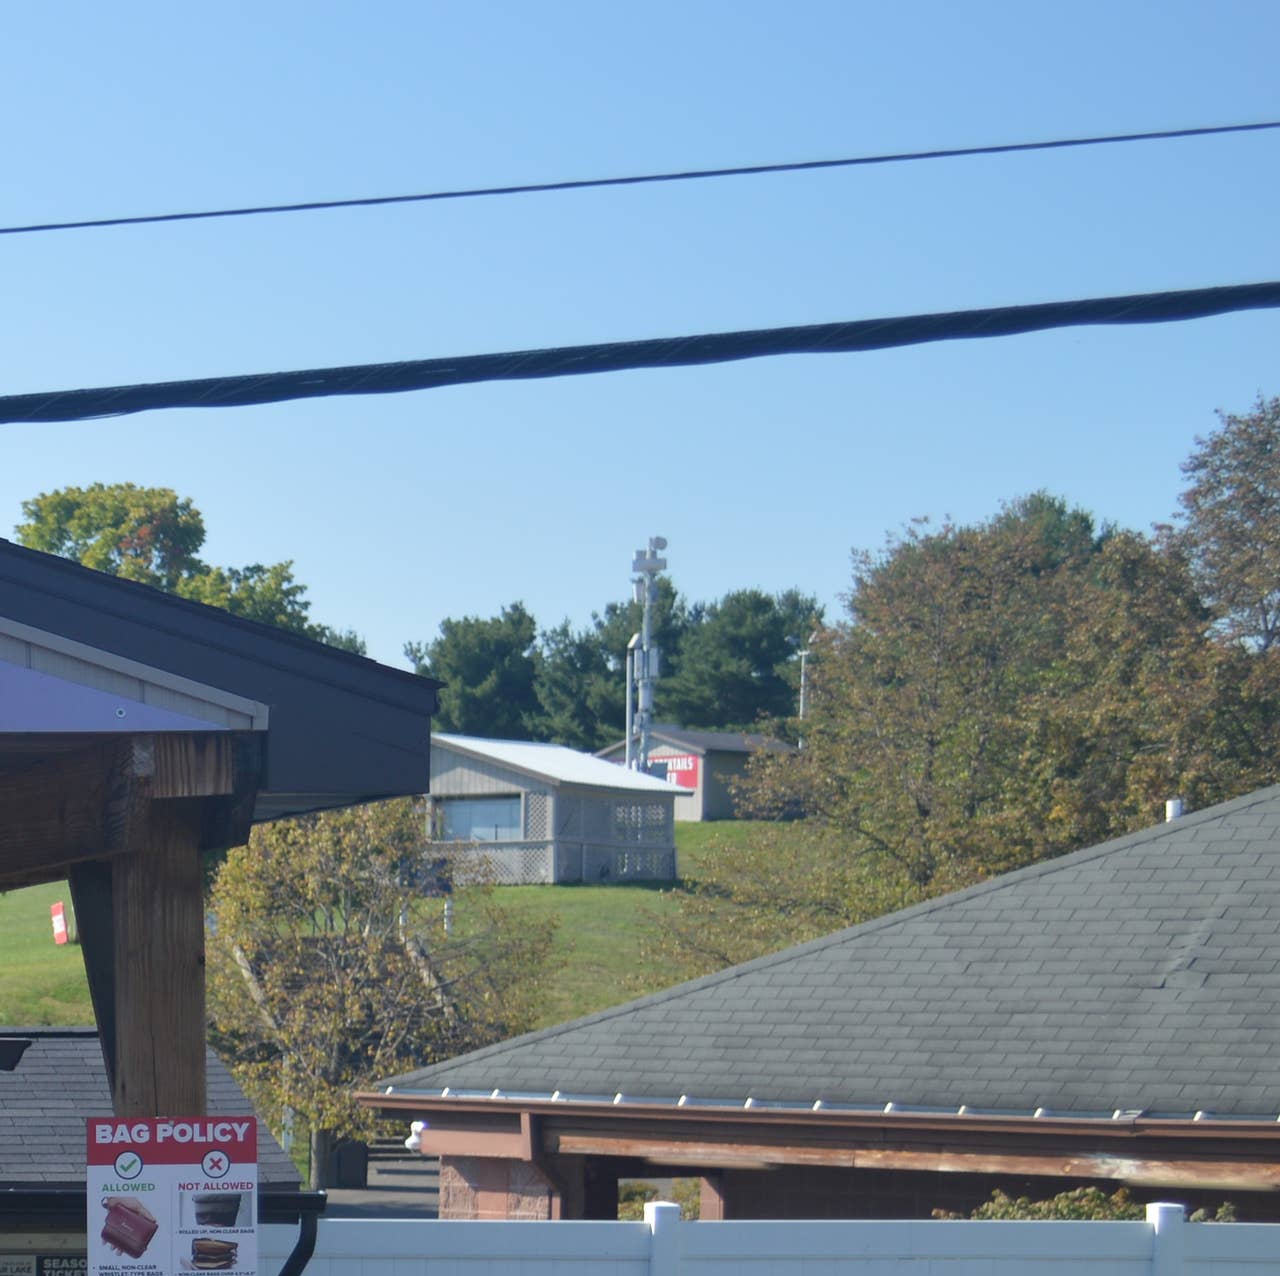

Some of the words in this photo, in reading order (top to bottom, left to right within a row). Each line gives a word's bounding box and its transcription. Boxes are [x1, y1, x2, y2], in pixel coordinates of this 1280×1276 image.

[95, 1124, 151, 1144] BAG
[156, 1122, 250, 1143] POLICY
[102, 1183, 156, 1192] ALLOWED
[178, 1182, 201, 1191] NOT
[203, 1182, 254, 1191] ALLOWED
[9, 1266, 33, 1274] LAKE
